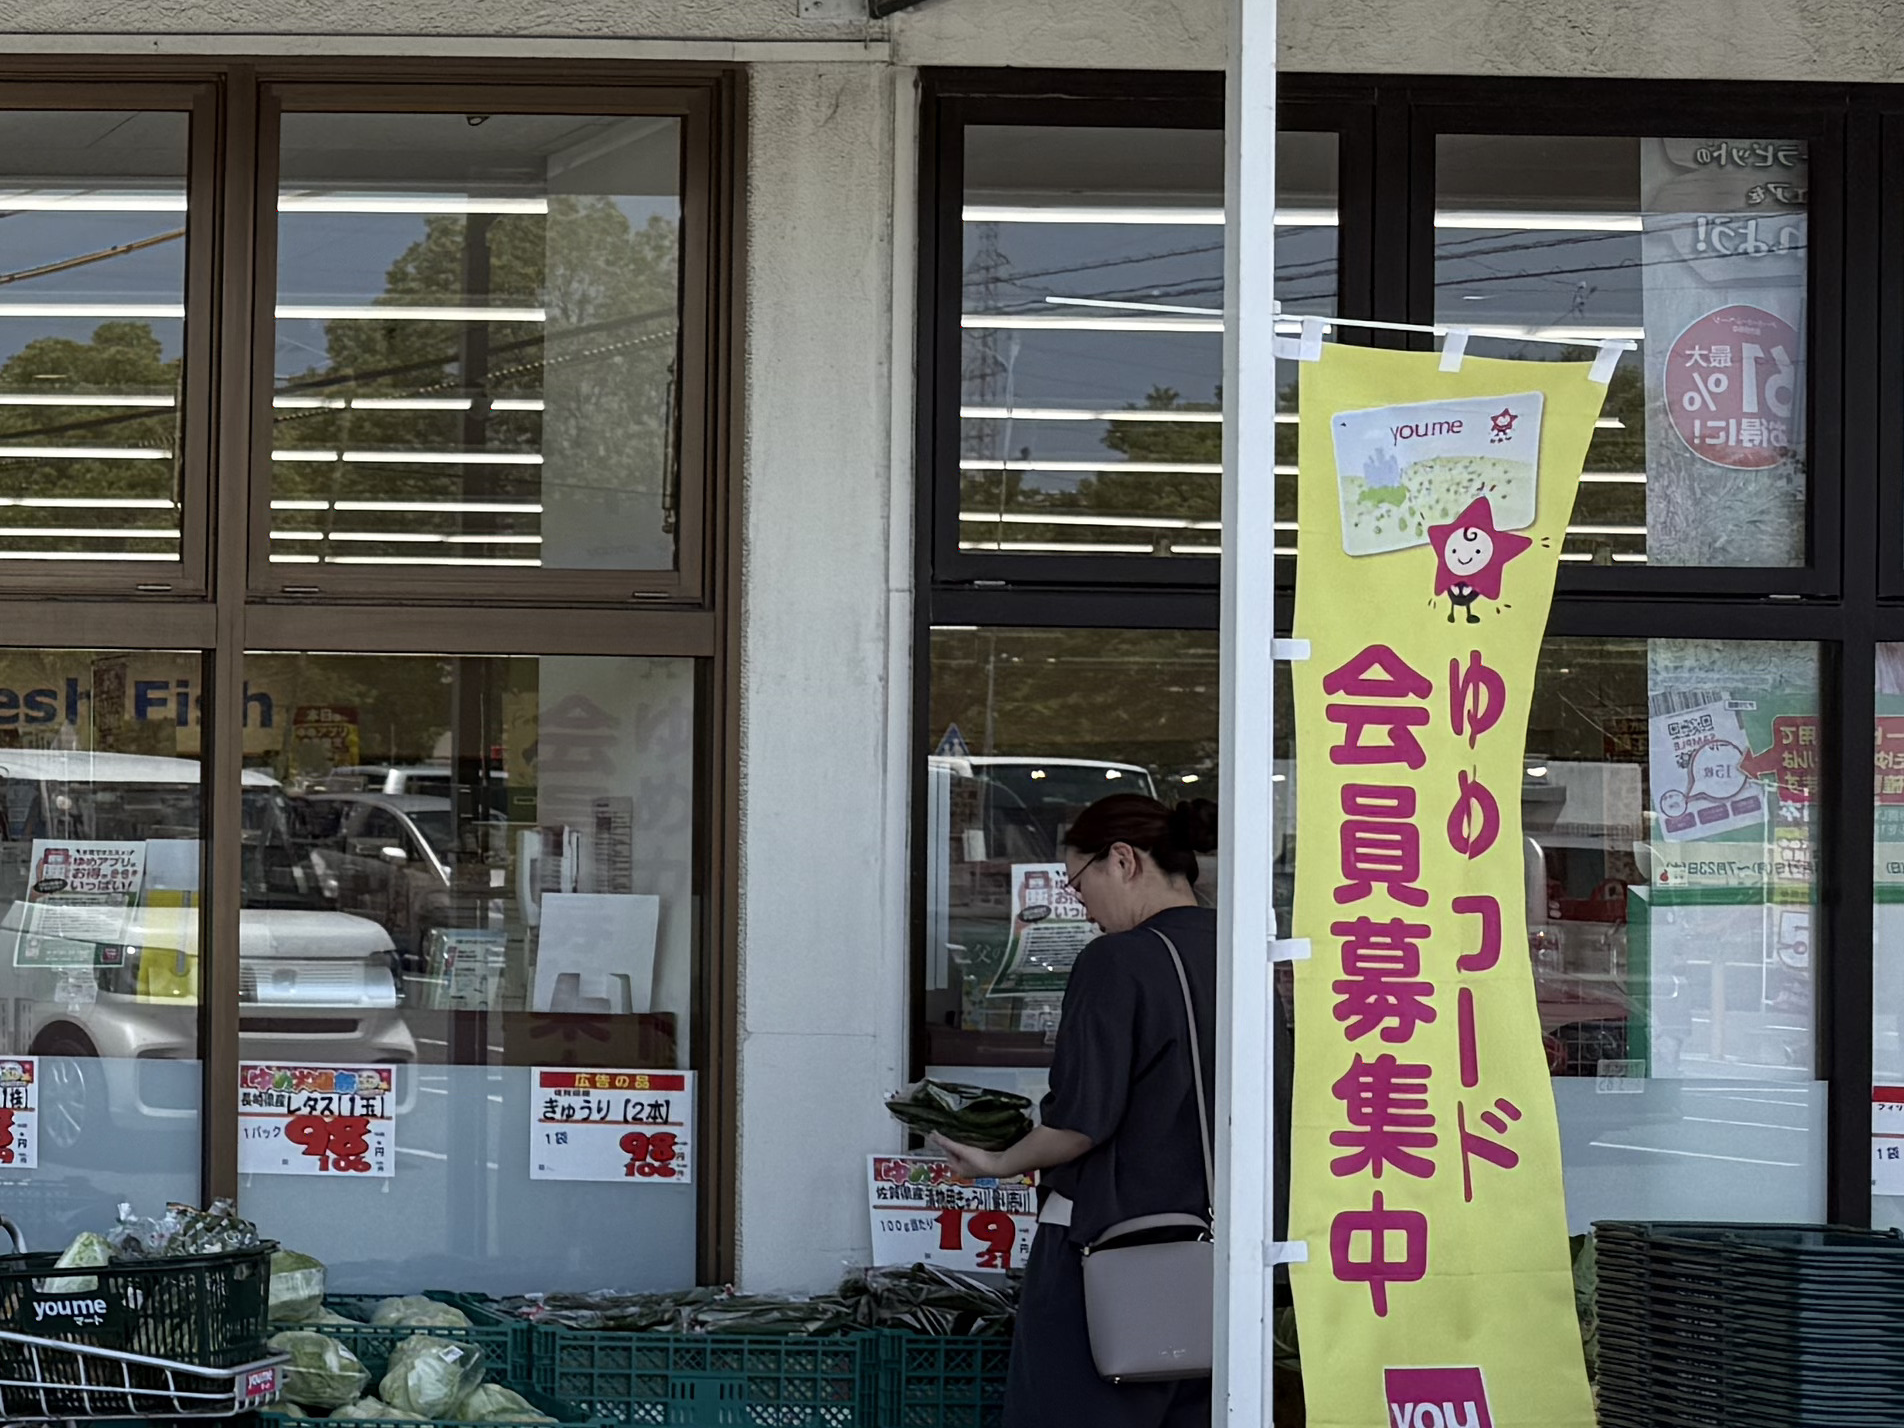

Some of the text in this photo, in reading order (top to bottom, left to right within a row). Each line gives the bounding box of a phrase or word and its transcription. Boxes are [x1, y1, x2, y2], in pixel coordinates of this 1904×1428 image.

[1391, 419, 1463, 446] youme
[134, 678, 274, 728] Fih
[1323, 644, 1438, 1318] 会員募集中
[574, 1073, 651, 1090] 広告の品
[542, 1097, 611, 1121] きゅうり
[284, 1115, 373, 1157] 98
[619, 1131, 679, 1163] 98
[933, 1208, 1017, 1254] 19
[32, 1298, 107, 1321] youme
